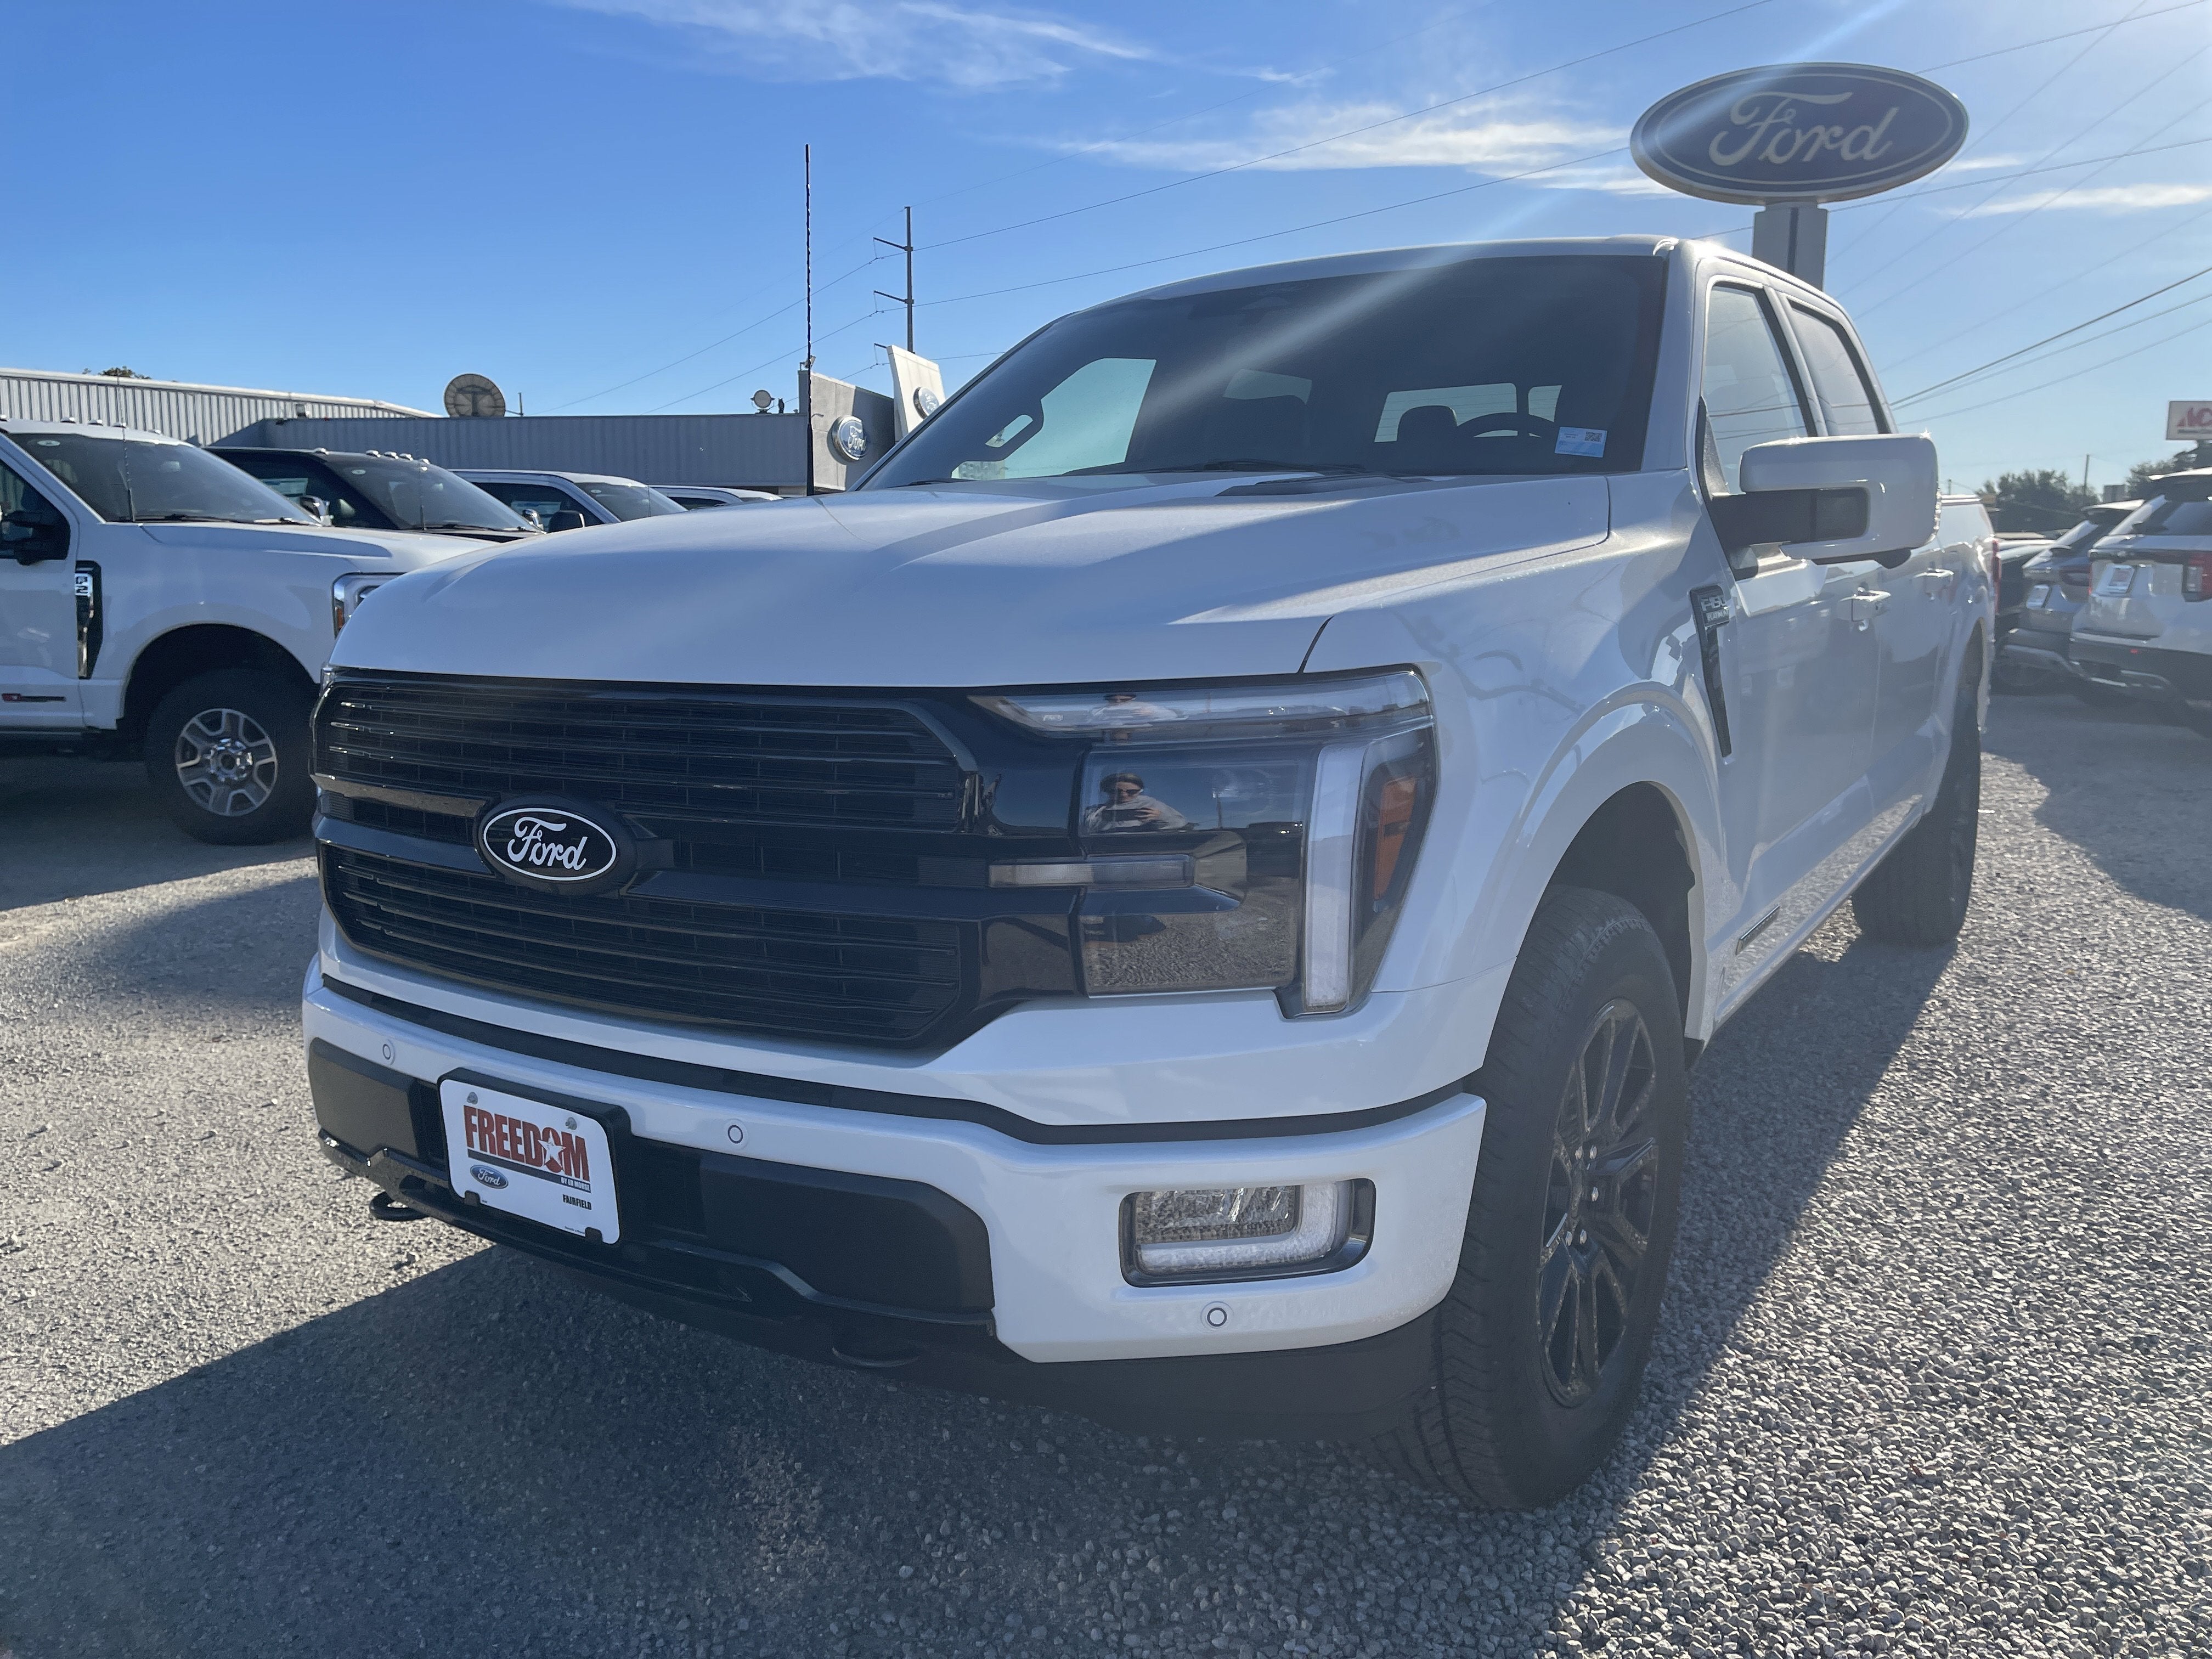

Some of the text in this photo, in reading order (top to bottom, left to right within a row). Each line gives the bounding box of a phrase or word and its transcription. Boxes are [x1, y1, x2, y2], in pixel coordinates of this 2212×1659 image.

[1708, 91, 1900, 166] Ford
[507, 816, 588, 871] Ford
[464, 1105, 590, 1182] FREEDOM
[478, 1168, 501, 1186] Ford
[563, 1194, 591, 1210] FAIRFIELD
